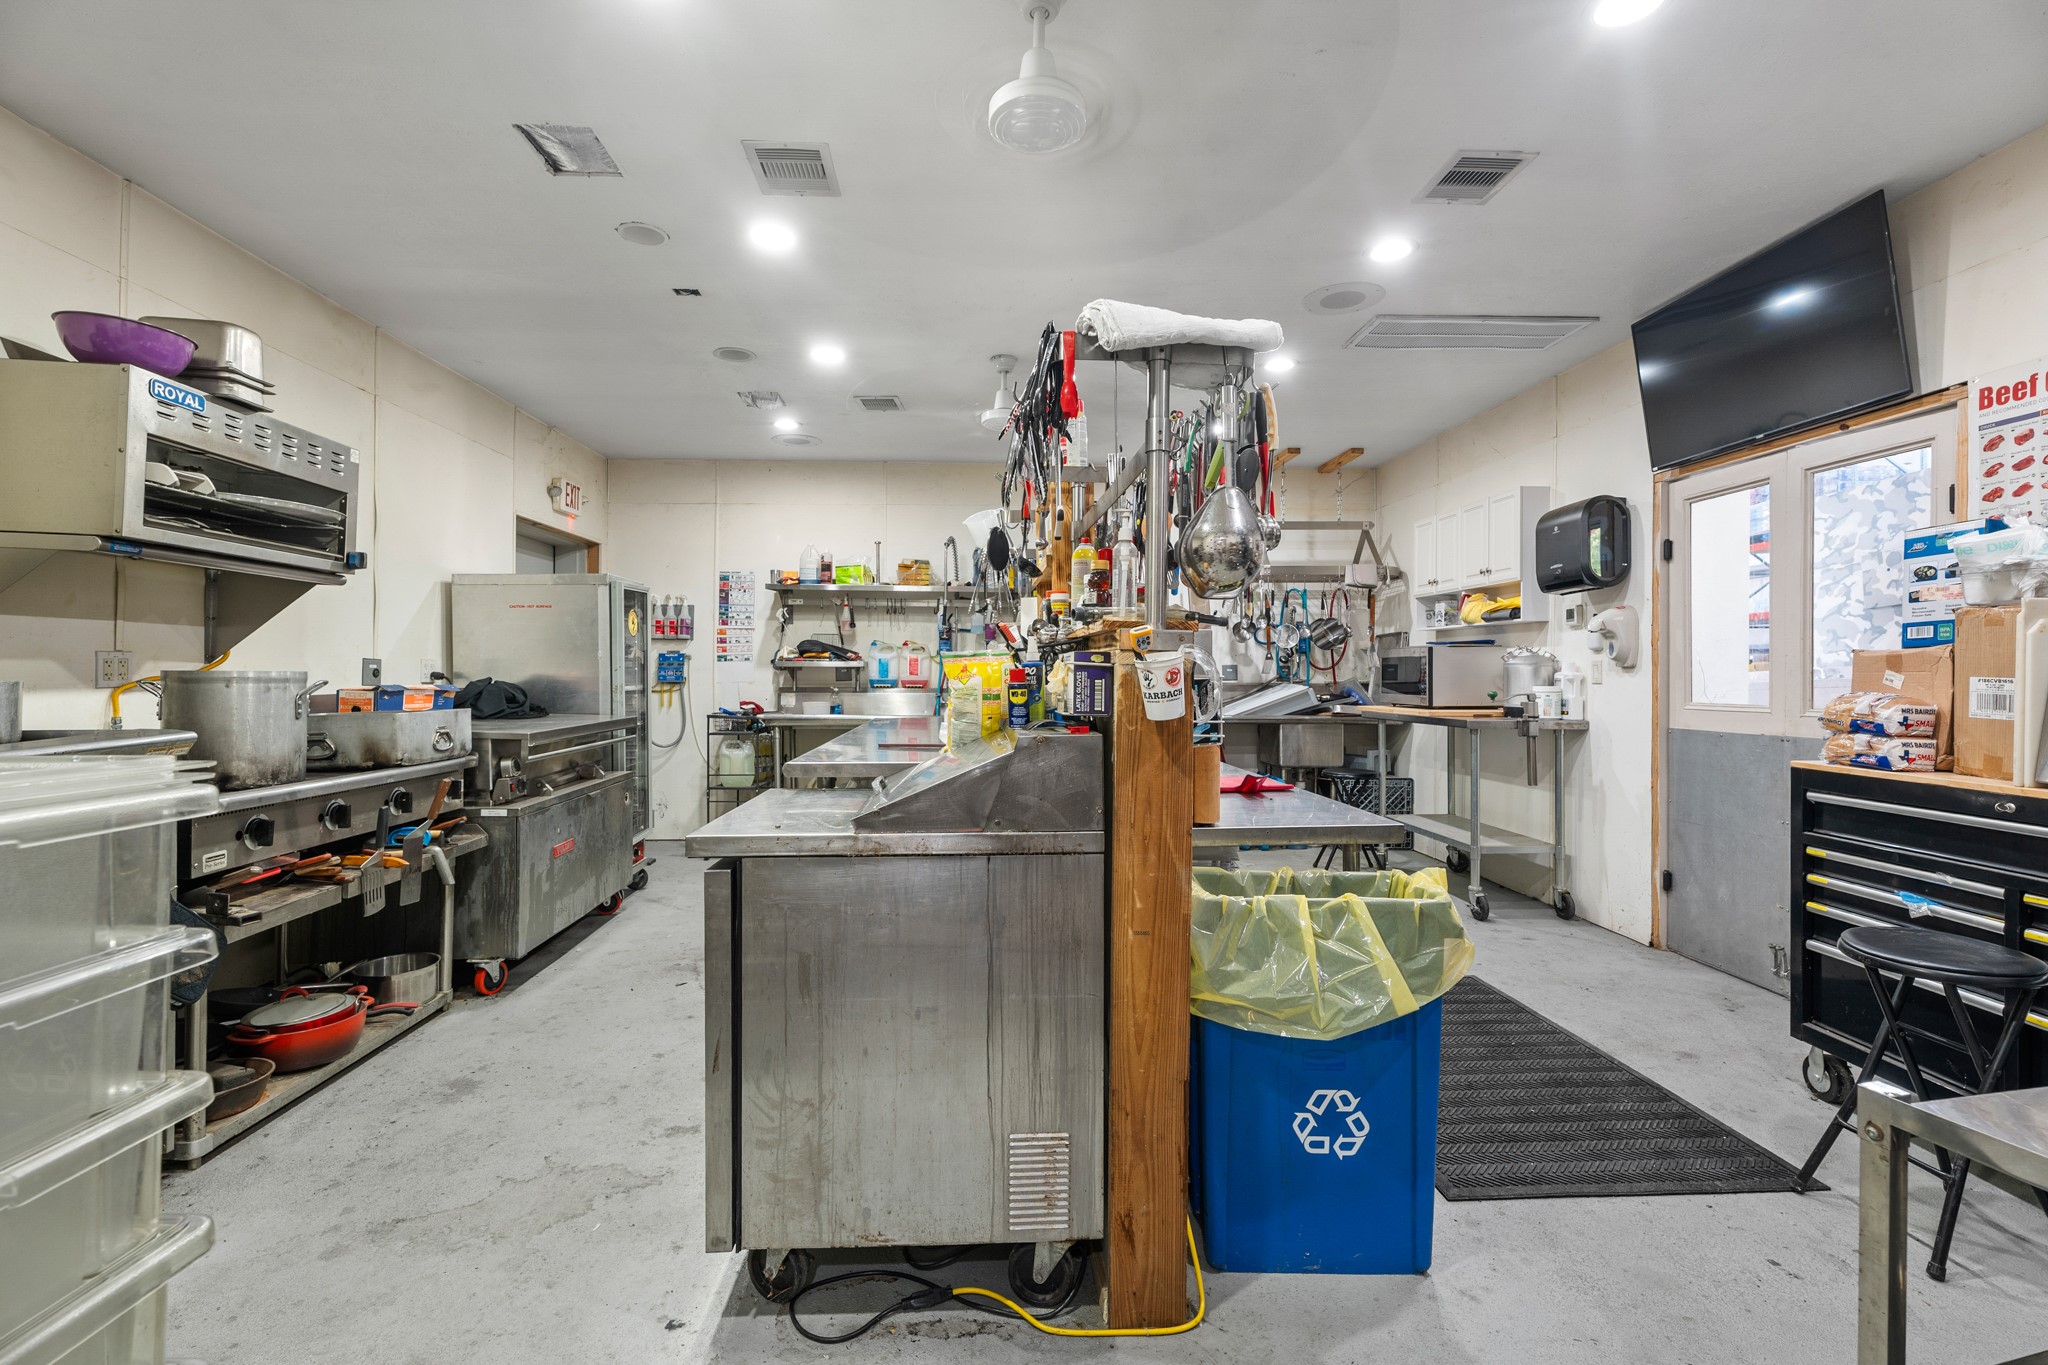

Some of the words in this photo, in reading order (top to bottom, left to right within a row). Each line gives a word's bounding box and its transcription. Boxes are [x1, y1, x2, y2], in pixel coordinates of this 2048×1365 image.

[154, 381, 203, 410] ROYAL
[1978, 372, 2039, 411] Beef
[1991, 400, 2037, 415] RECOMMENDED
[565, 481, 581, 511] EXIT
[1011, 690, 1027, 698] WD-40
[1143, 687, 1183, 700] KARBACH
